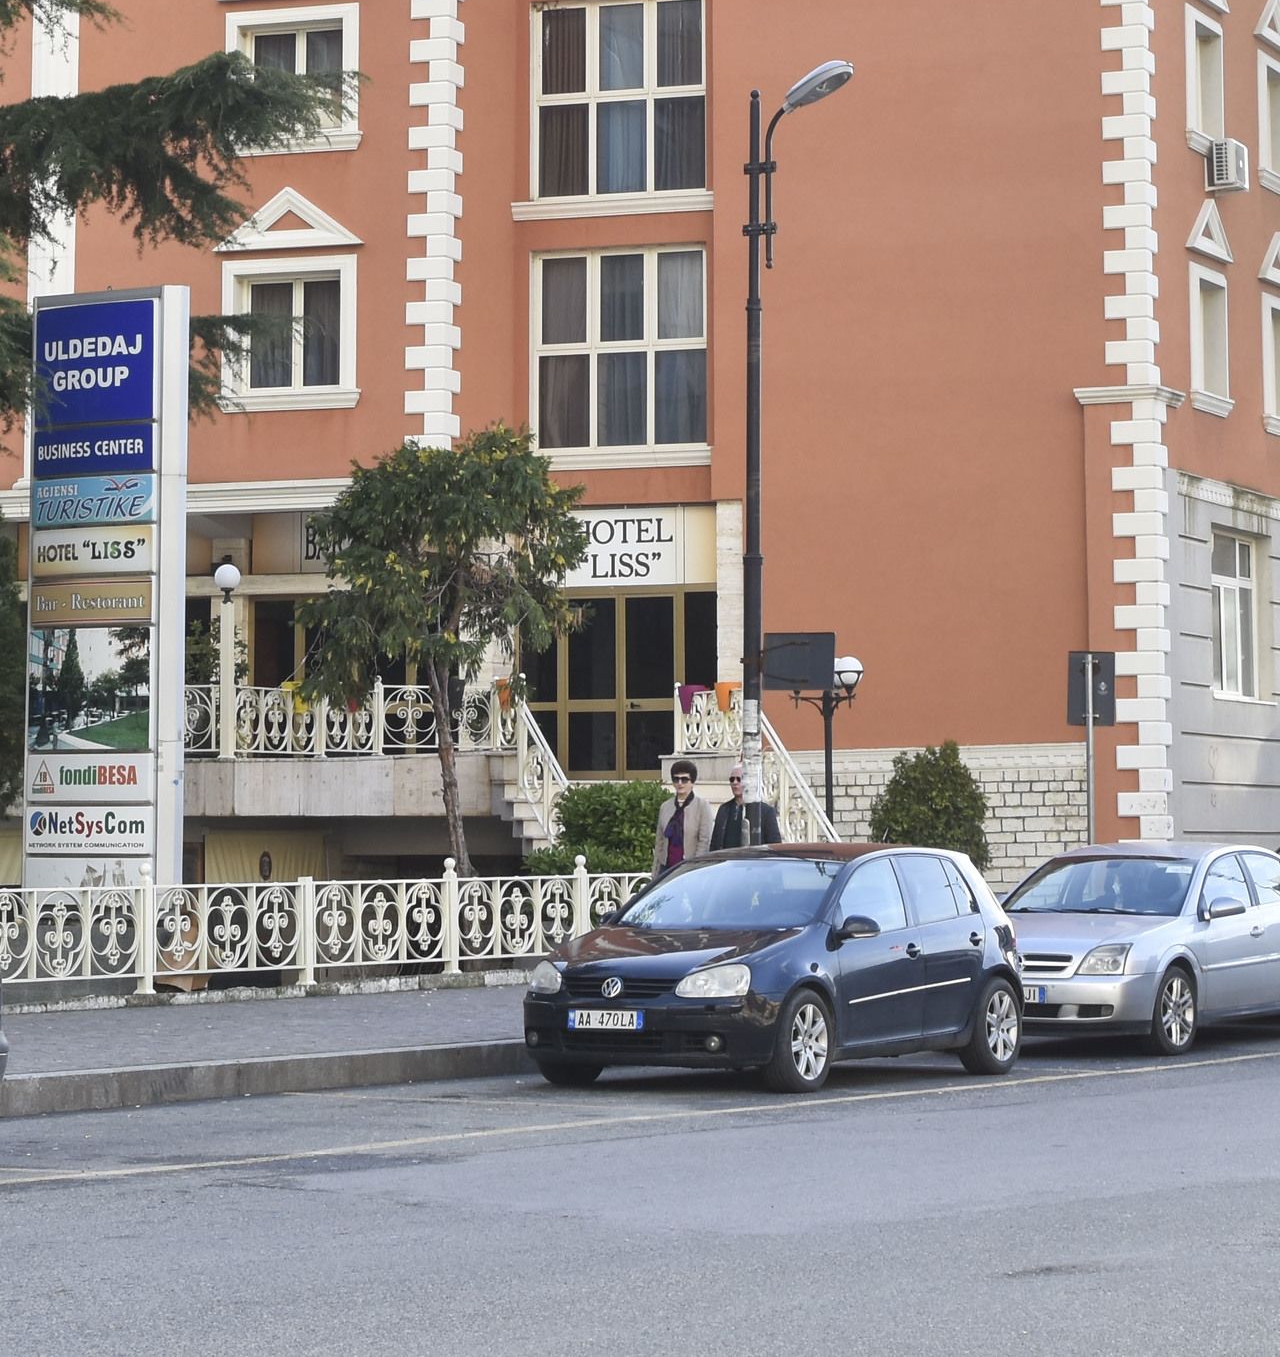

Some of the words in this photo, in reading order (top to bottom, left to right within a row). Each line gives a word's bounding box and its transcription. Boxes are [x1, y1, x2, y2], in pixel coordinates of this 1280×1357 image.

[44, 333, 143, 362] ULDEDAJ
[53, 366, 129, 392] GROUP
[38, 442, 90, 461] BUSINESS
[95, 439, 144, 456] CENTER
[37, 484, 78, 499] AGJENSI
[37, 495, 145, 522] TURISTIKE
[579, 518, 673, 544] HOTEL
[37, 545, 78, 563] HOTEL
[83, 538, 146, 560] “LISS”
[37, 595, 58, 611] Bar
[71, 593, 144, 611] Restorant
[60, 765, 137, 785] fondiBESA
[48, 811, 144, 838] NetSysCom
[578, 1012, 591, 1026] AA
